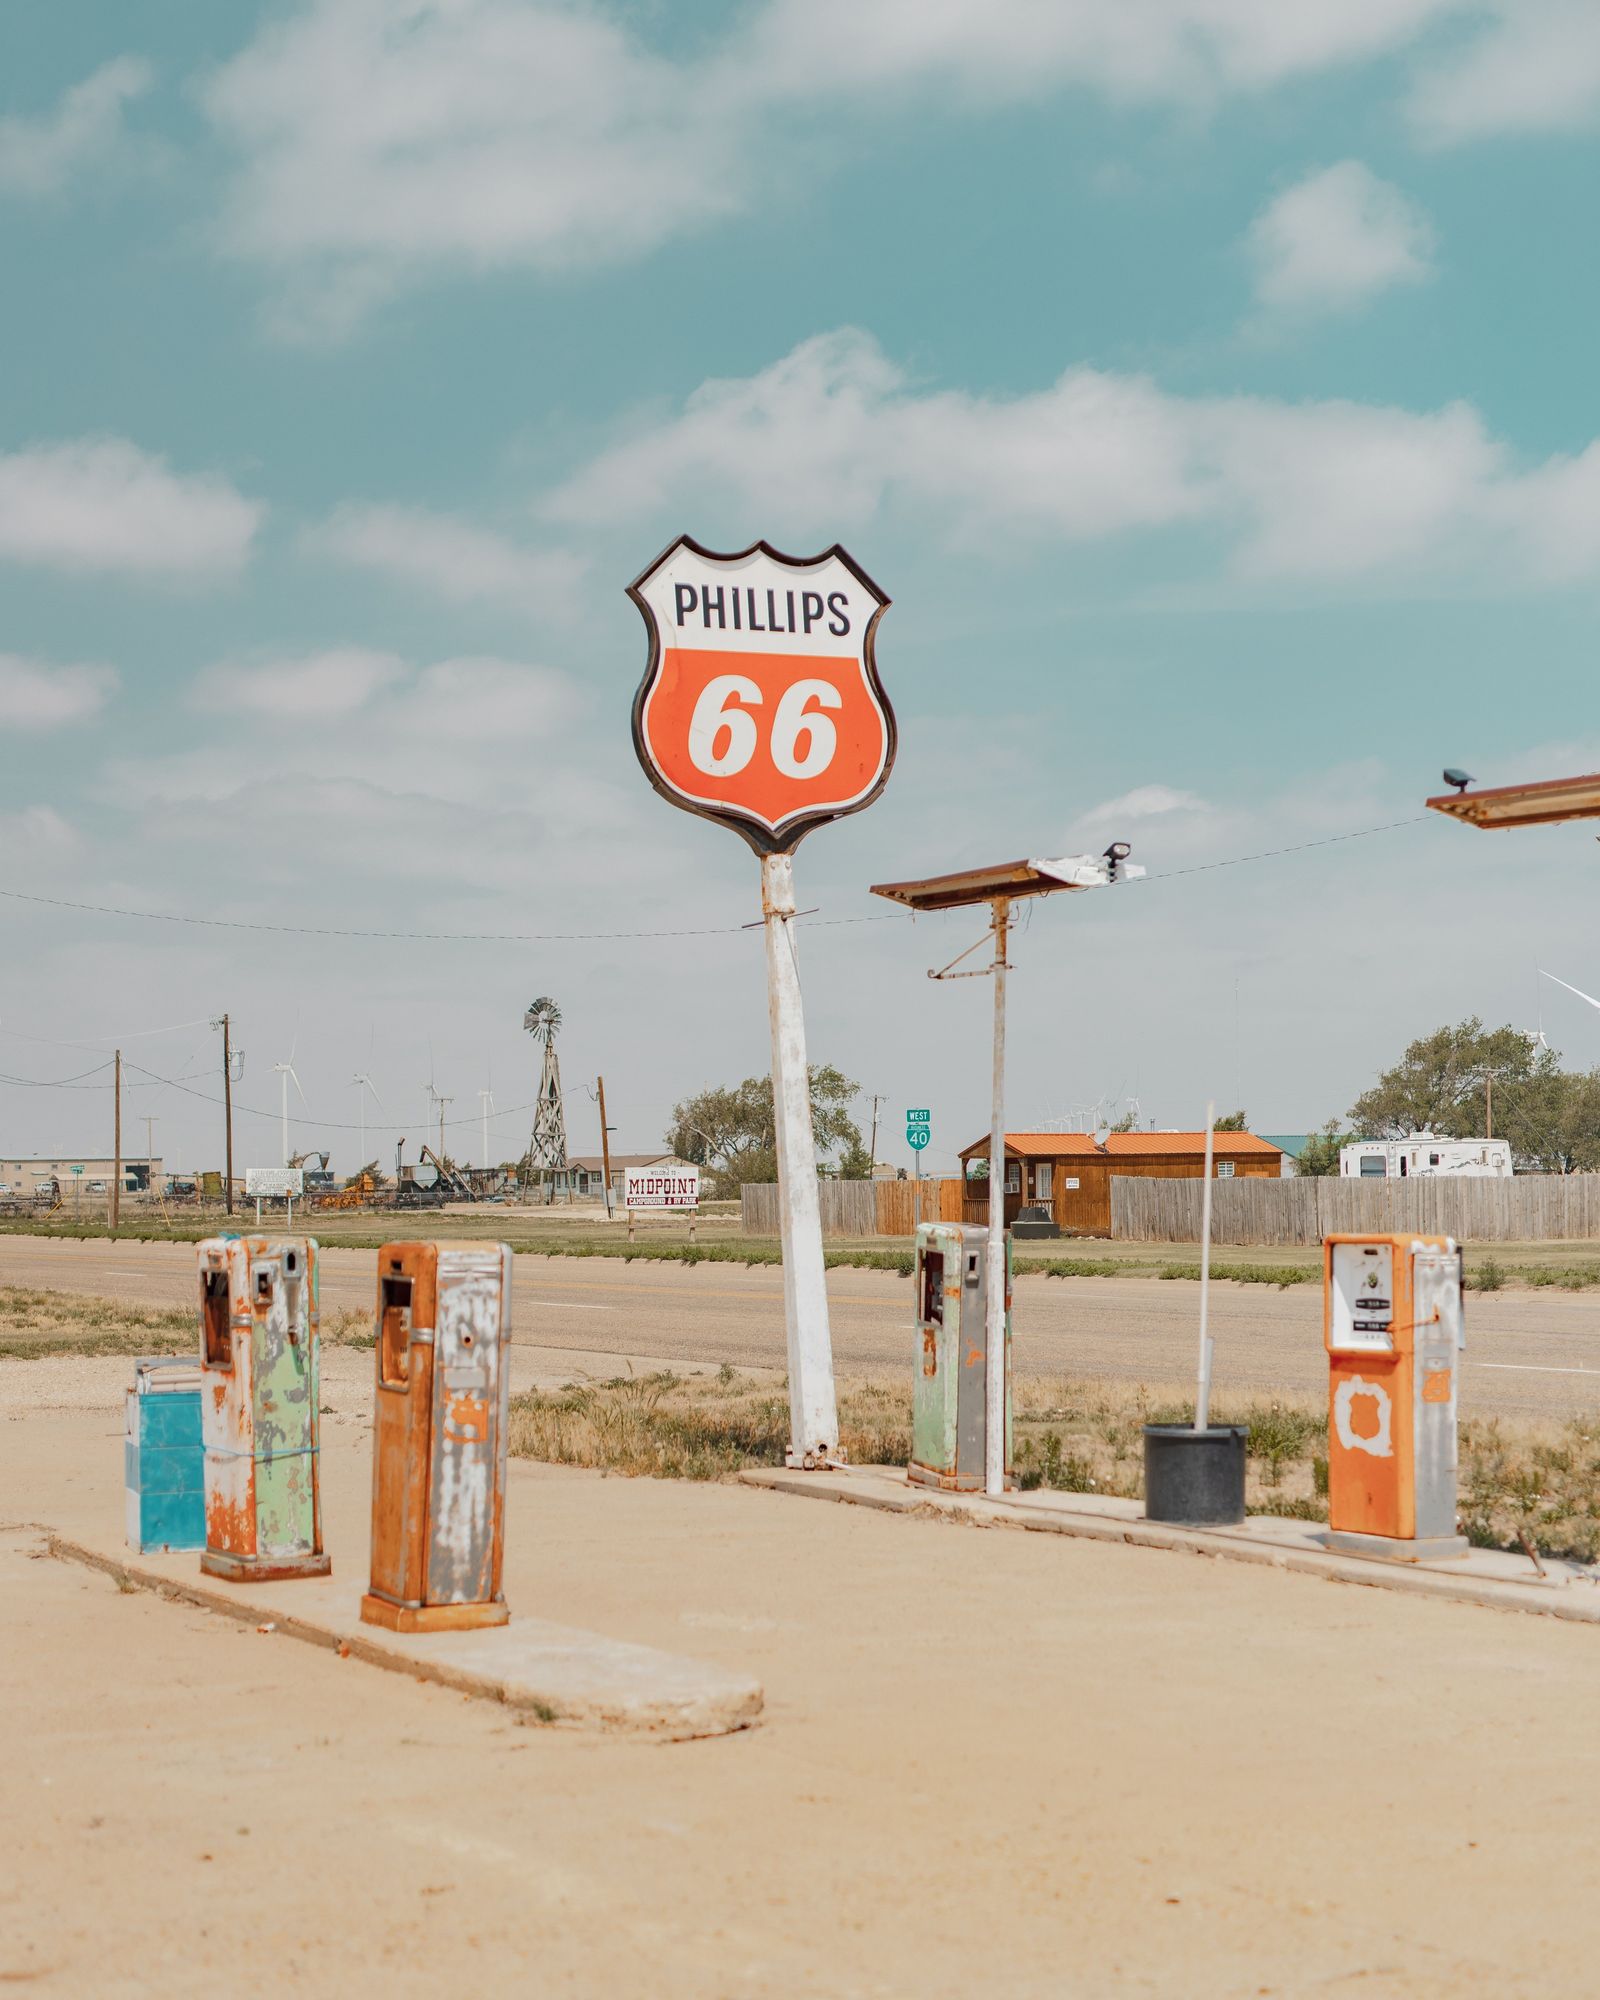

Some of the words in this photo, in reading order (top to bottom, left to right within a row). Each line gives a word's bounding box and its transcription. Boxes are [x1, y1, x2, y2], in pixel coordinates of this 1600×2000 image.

[674, 582, 851, 637] PHILLIPS
[688, 674, 843, 780] 66
[909, 1111, 928, 1120] WEST
[909, 1132, 928, 1145] 40
[629, 1178, 696, 1194] MIDPOINT
